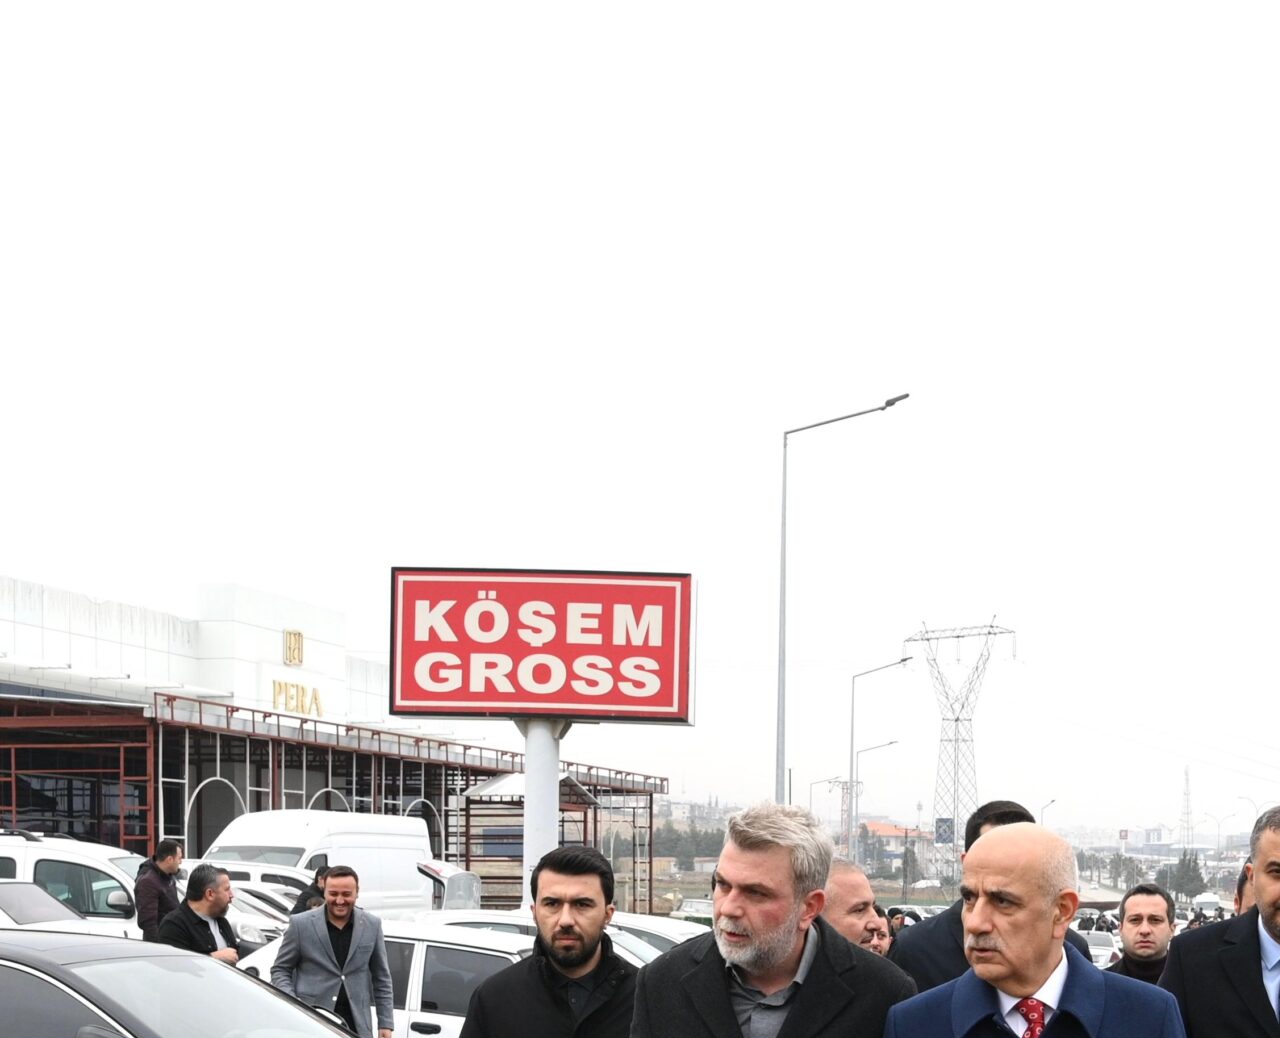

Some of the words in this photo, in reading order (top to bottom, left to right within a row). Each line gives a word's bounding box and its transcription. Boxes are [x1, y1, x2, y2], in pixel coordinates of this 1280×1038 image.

[414, 590, 664, 648] KÖŞEM
[413, 651, 662, 698] GROSS
[273, 679, 323, 718] PERA
